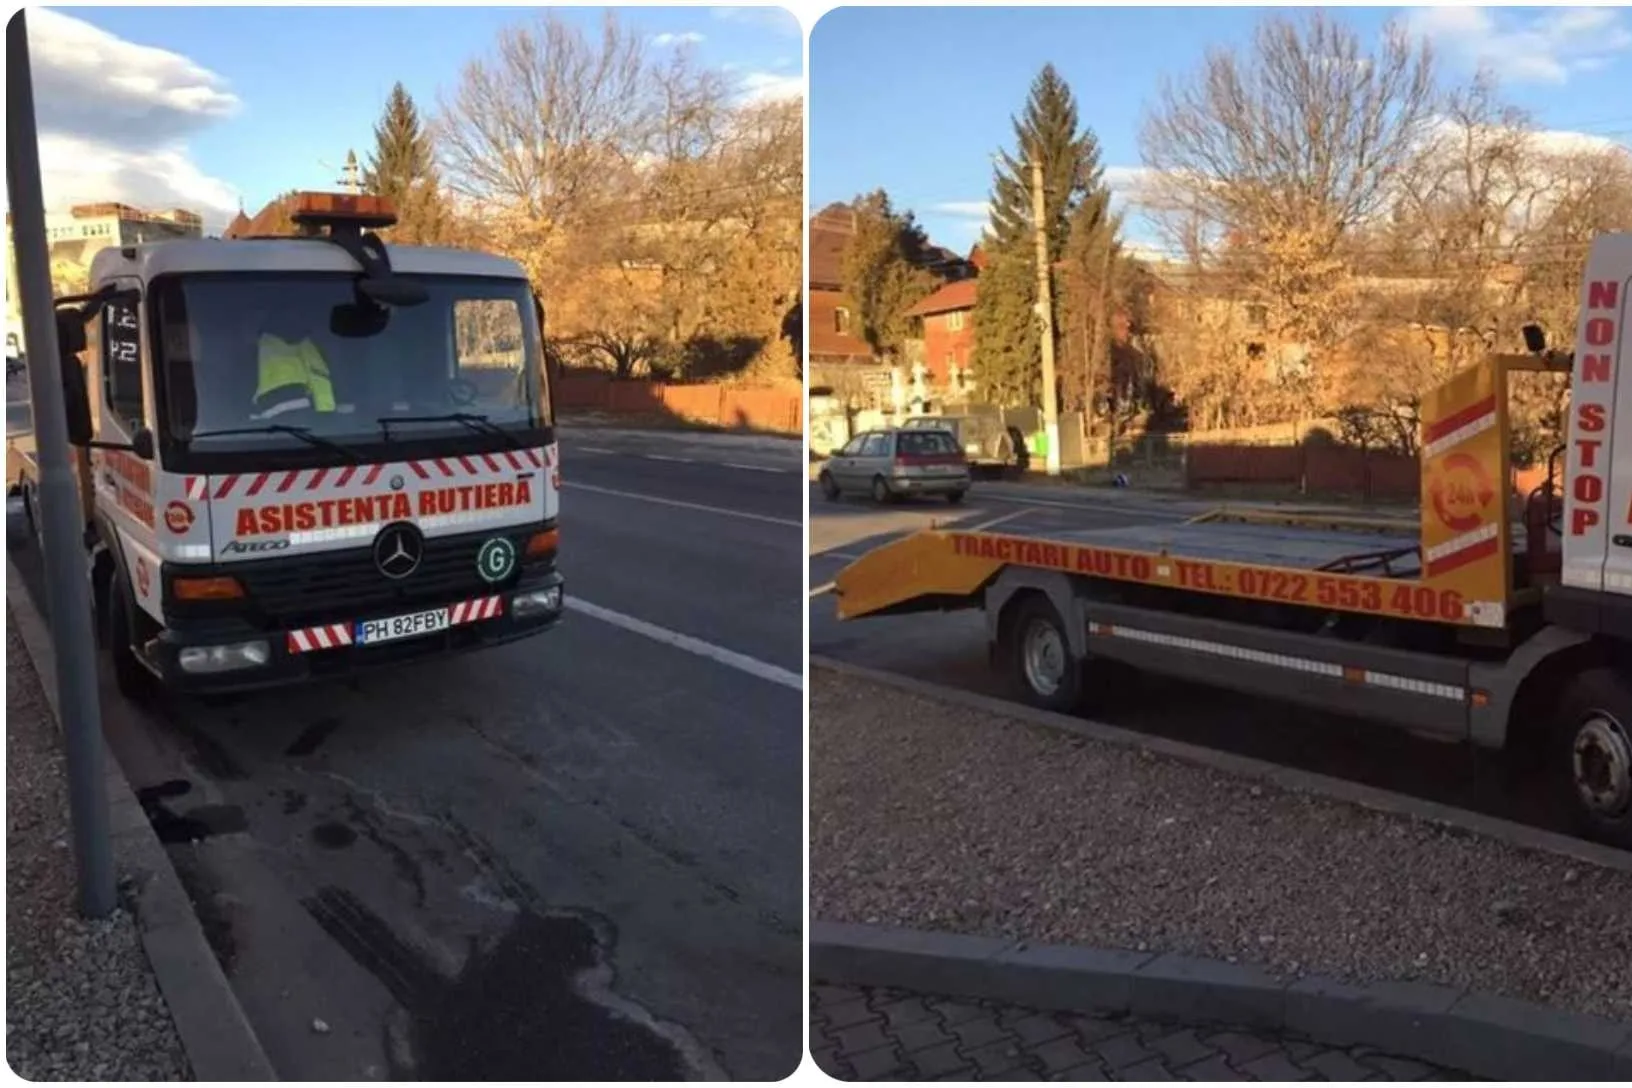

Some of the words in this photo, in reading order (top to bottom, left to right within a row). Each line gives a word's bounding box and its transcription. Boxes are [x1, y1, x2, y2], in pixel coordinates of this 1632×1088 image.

[1582, 281, 1618, 382] NON
[1572, 404, 1604, 535] STOP
[236, 493, 411, 537] ASISTENTA
[418, 480, 531, 515] RUTIERA
[489, 547, 505, 571] G
[952, 534, 1069, 569] TRACTARI
[1076, 550, 1150, 580] AUTO
[1238, 568, 1307, 601] 0722
[1317, 578, 1383, 611] 553
[1390, 585, 1465, 620] 406
[364, 621, 388, 641] PH
[393, 610, 446, 635] 82FBY
